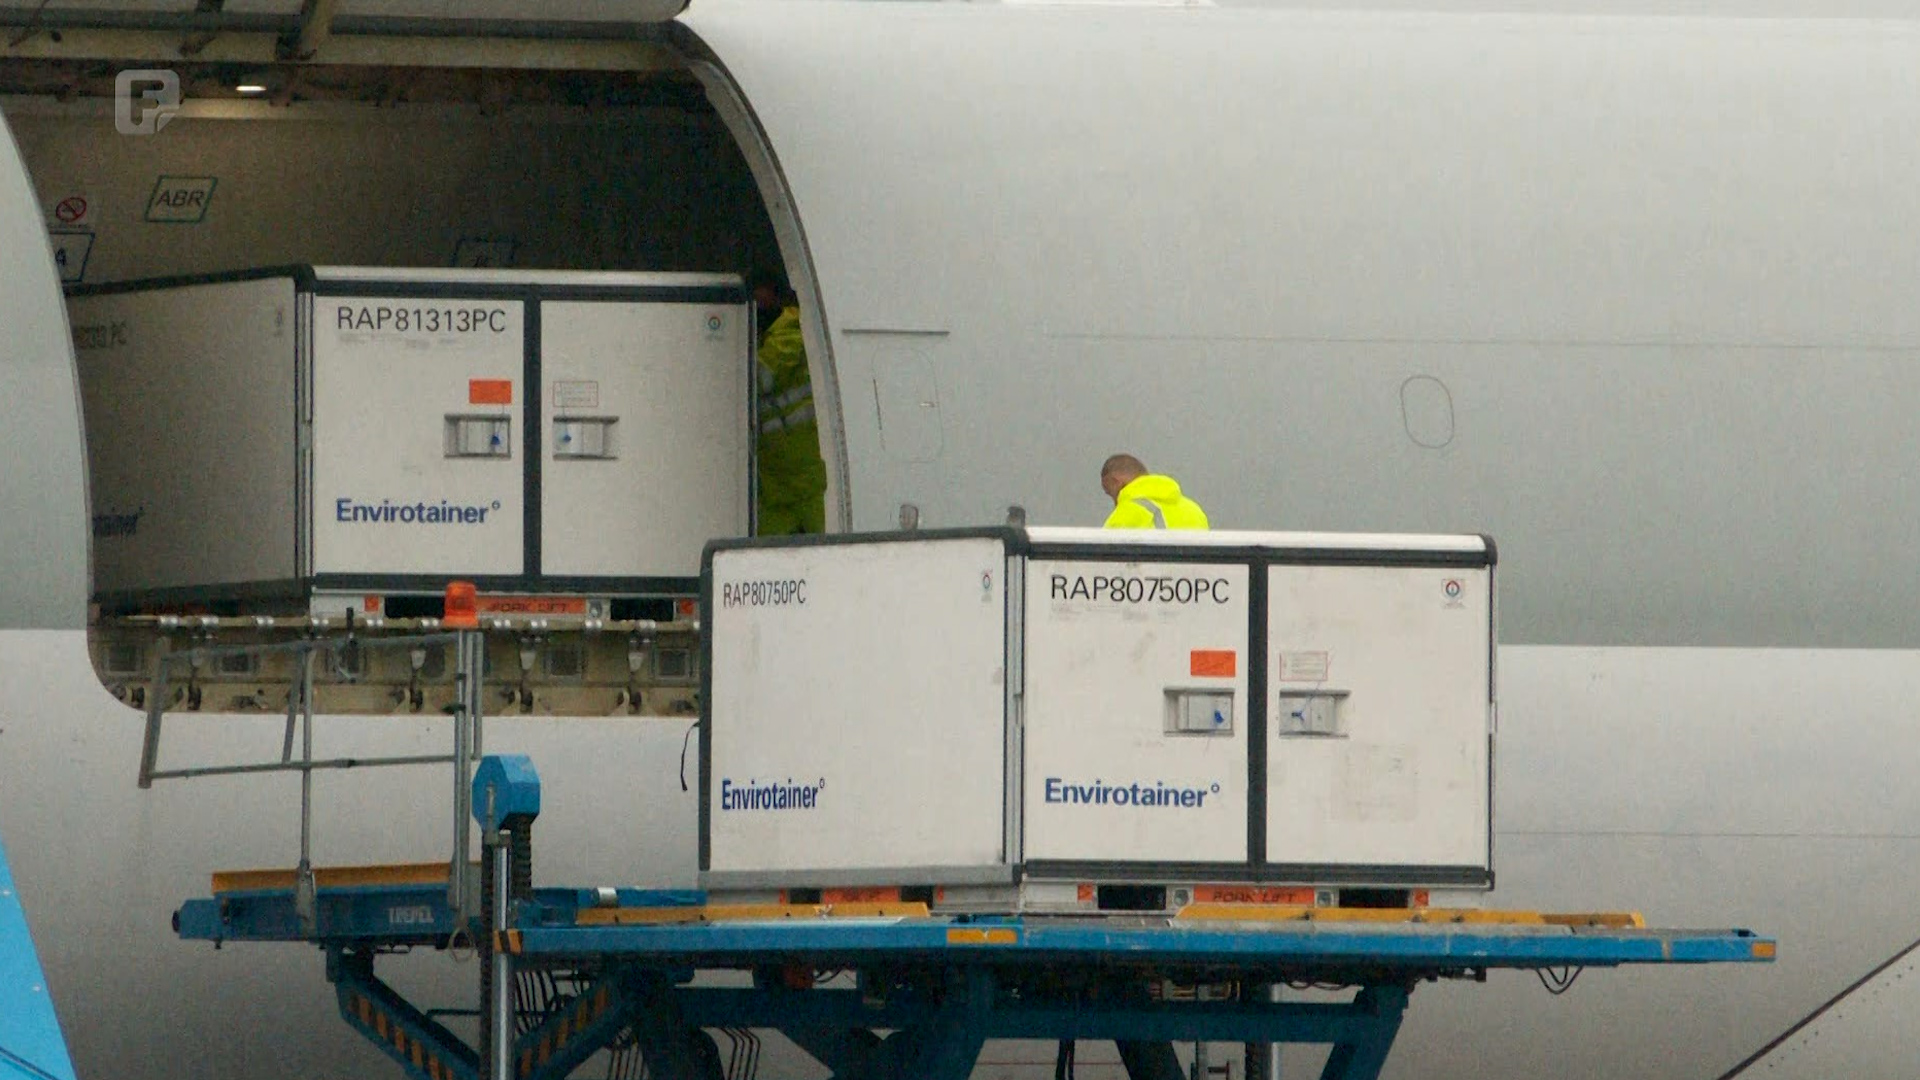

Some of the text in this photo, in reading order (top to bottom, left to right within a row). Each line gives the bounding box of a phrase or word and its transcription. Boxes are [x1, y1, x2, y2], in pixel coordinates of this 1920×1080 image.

[156, 189, 205, 207] ABR
[337, 306, 506, 332] RAP81313PC
[723, 579, 806, 608] RAP80750PC
[1051, 574, 1230, 604] RAP80750PC
